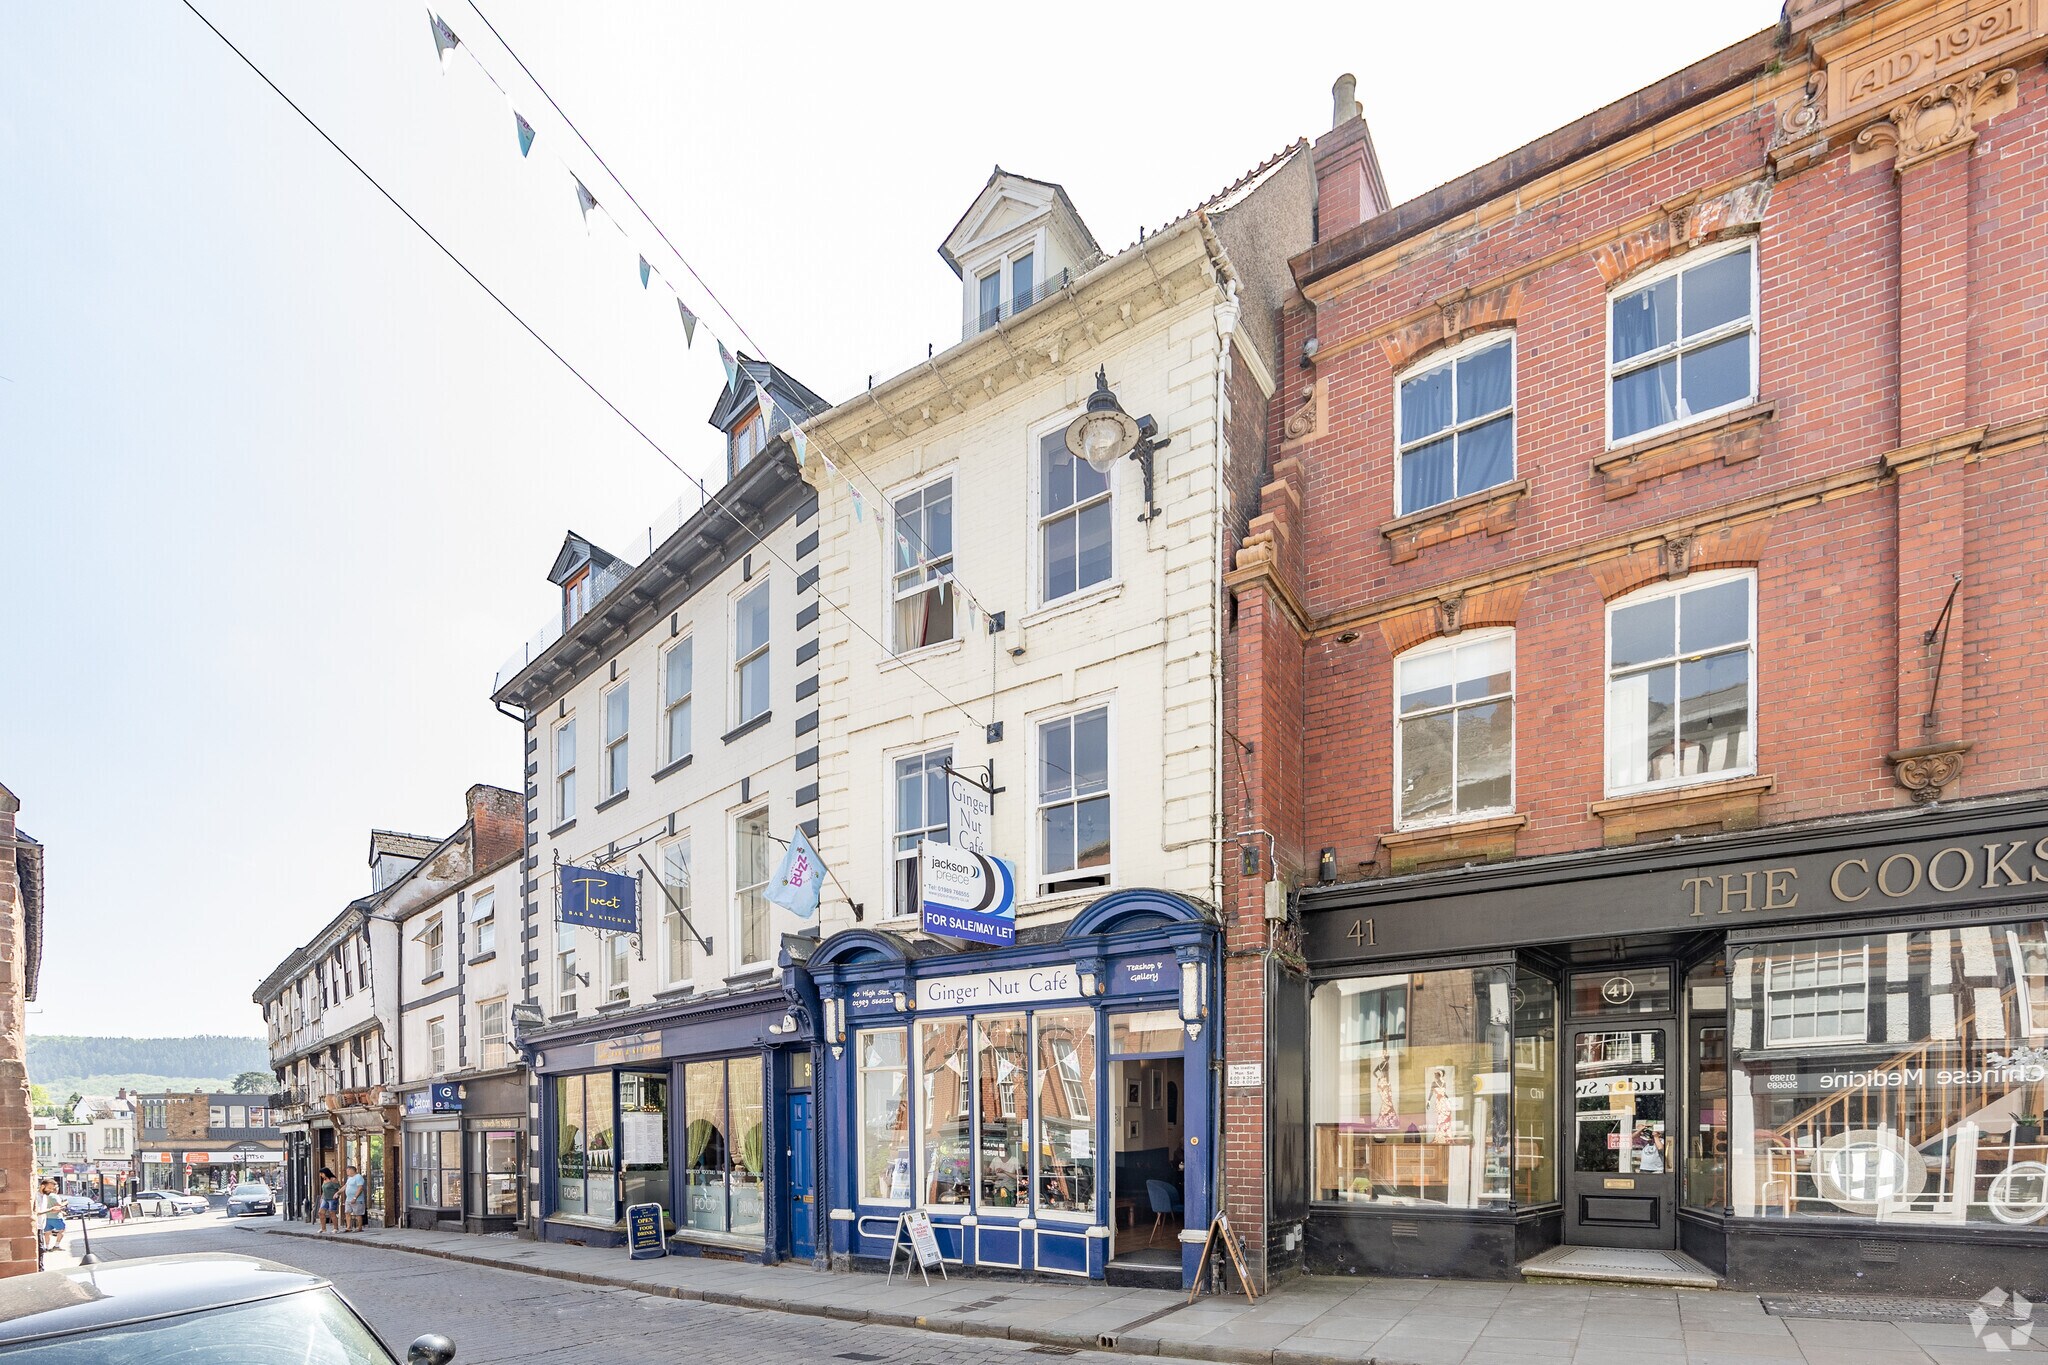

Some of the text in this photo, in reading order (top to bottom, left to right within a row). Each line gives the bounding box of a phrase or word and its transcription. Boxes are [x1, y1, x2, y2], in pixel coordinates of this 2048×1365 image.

[952, 780, 989, 815] Ginger
[960, 807, 982, 834] Nut
[959, 830, 984, 854] Café
[932, 856, 969, 874] jackson
[937, 870, 969, 885] preece
[572, 878, 621, 911] Tweet
[1680, 867, 1799, 917] THE
[599, 915, 632, 924] KITCHEN
[927, 913, 1014, 939] FOR SALE/MAY LET
[1346, 919, 1376, 947] 41
[1126, 963, 1156, 971] Teashop
[1130, 973, 1159, 982] Gallery
[863, 990, 876, 998] High
[928, 972, 1068, 1004] Ginger Nut Café
[1607, 983, 1628, 998] 41
